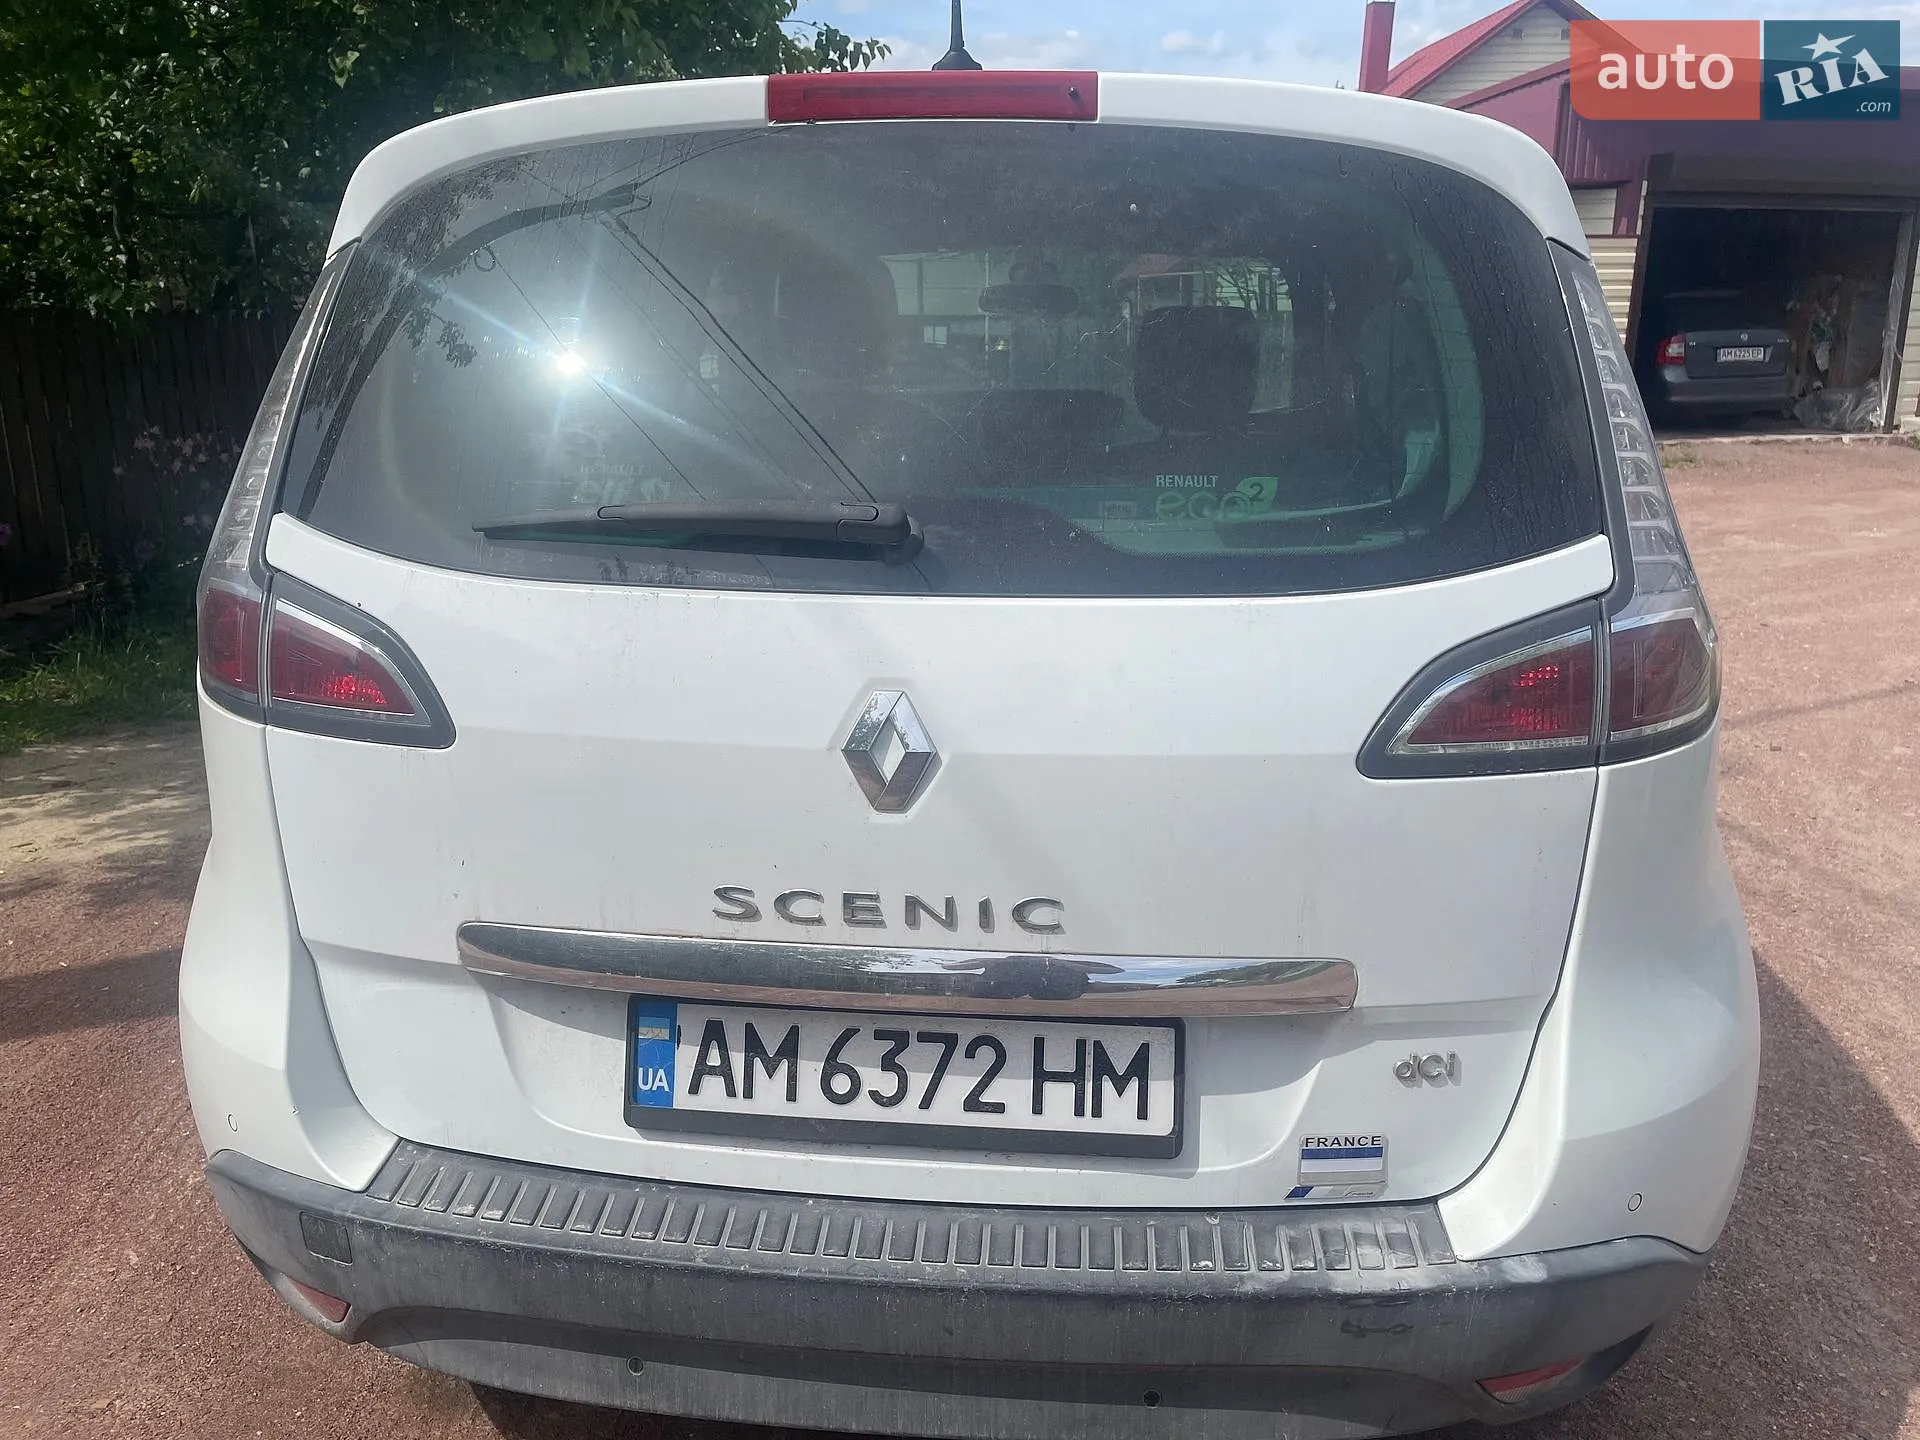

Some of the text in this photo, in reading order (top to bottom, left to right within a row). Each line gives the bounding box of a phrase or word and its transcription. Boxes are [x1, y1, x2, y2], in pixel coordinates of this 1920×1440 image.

[1155, 474, 1218, 488] RENAULT
[713, 885, 1065, 935] SCENIC
[638, 1067, 670, 1092] UA
[687, 1019, 1151, 1120] AM 6372 HM
[1304, 1135, 1382, 1148] FRANCE
